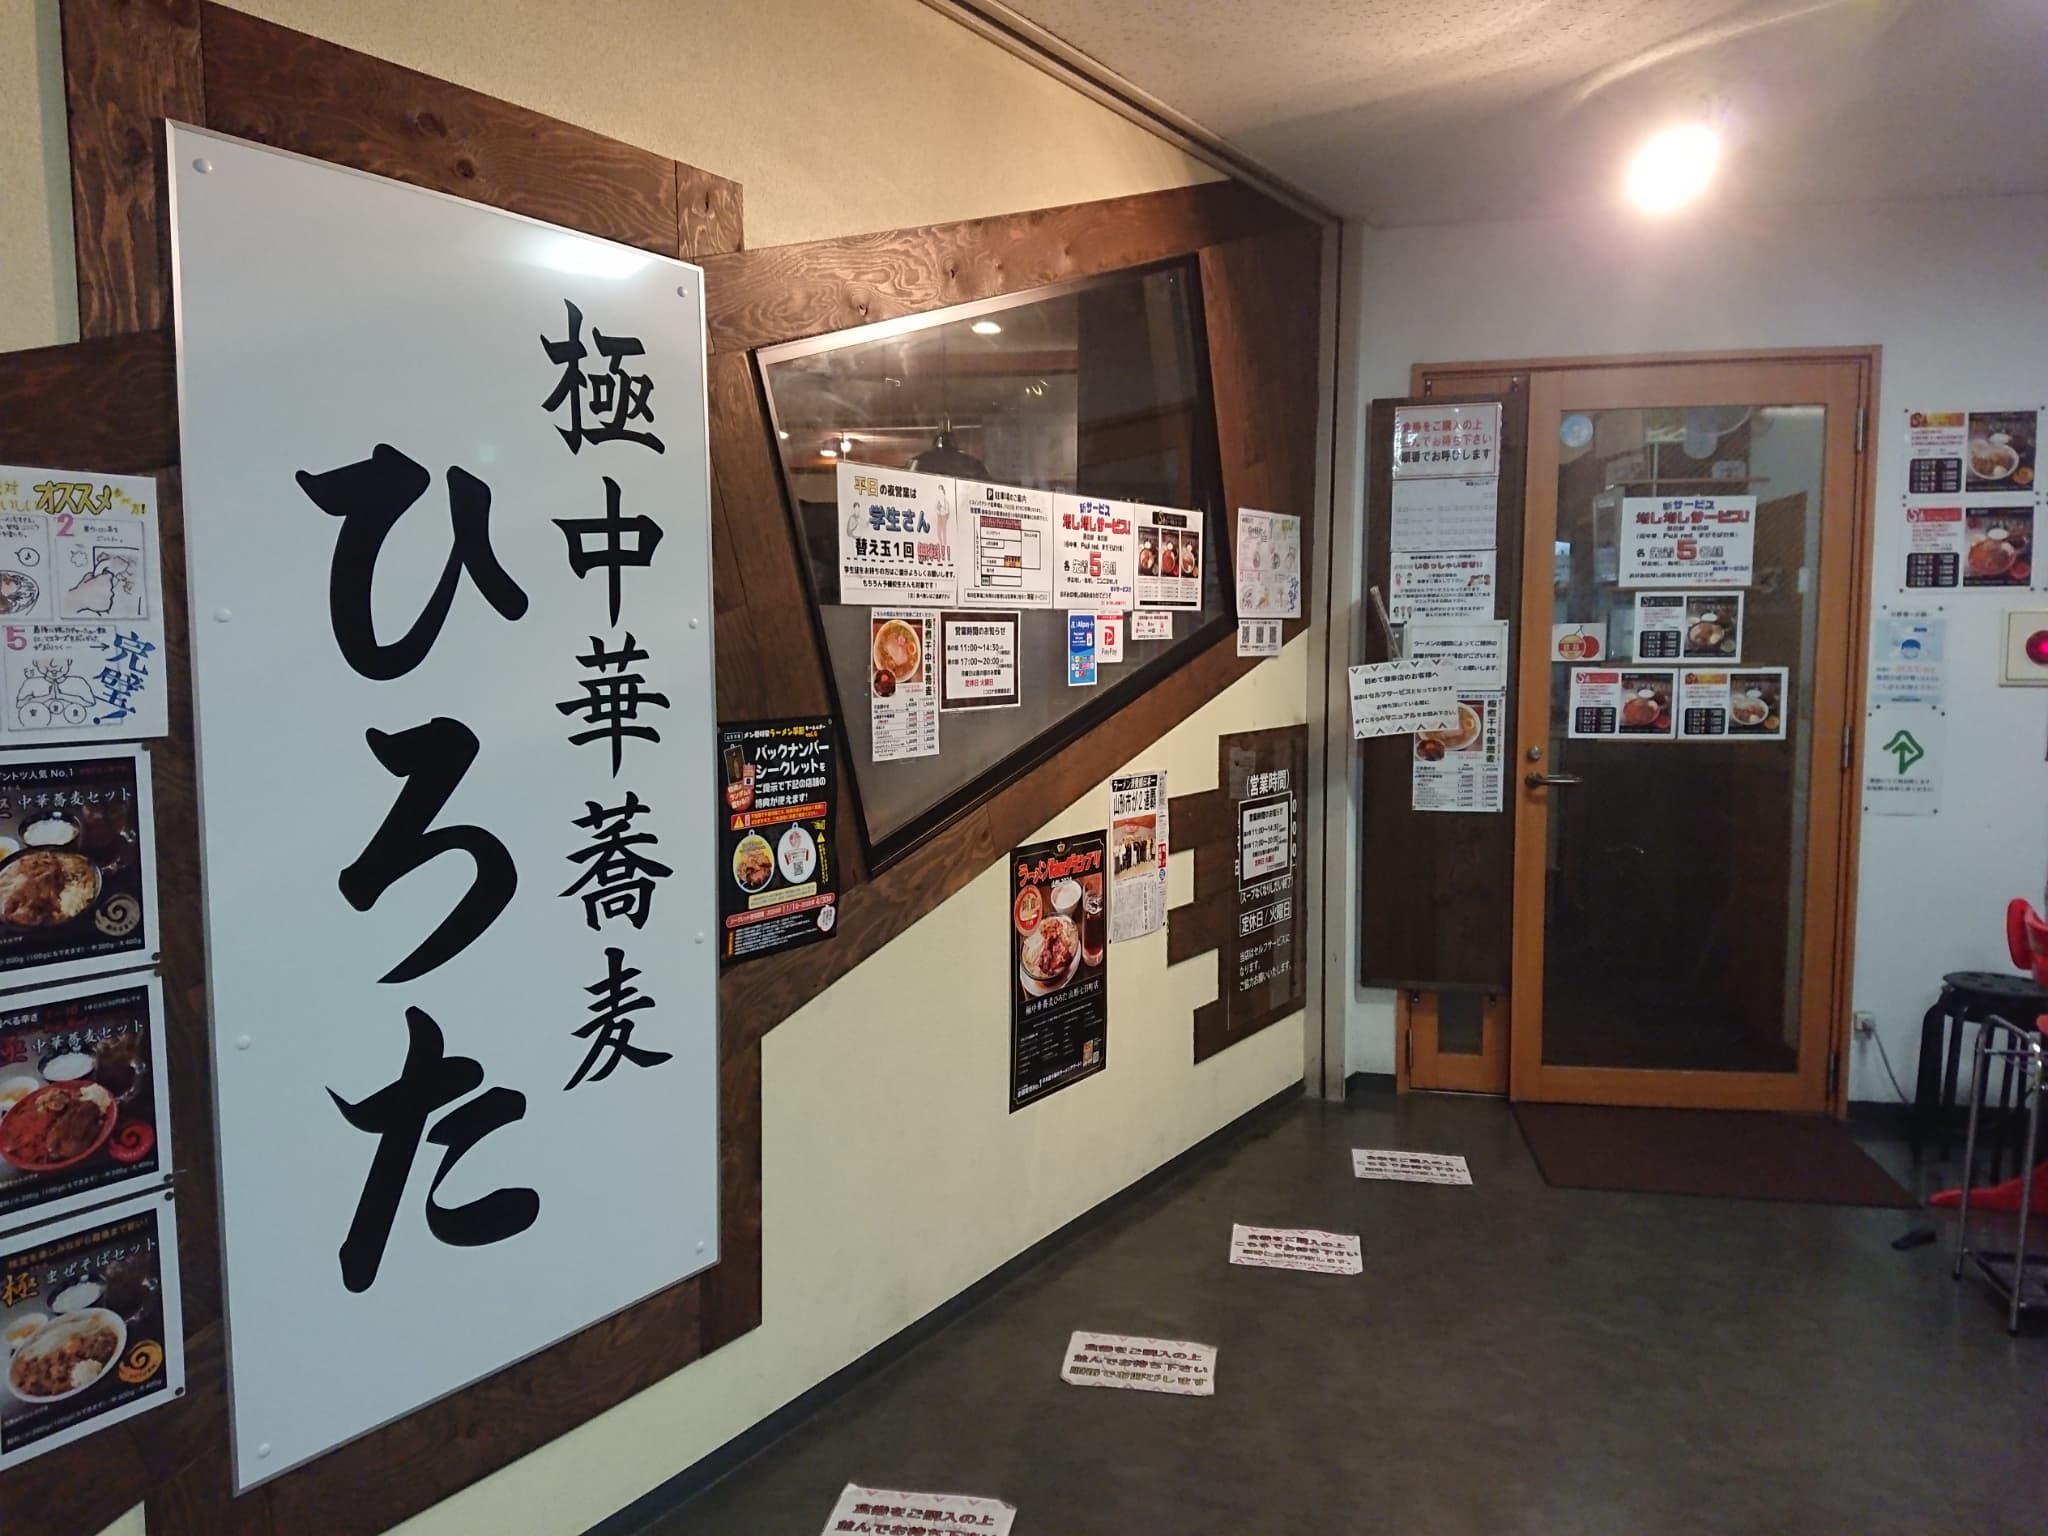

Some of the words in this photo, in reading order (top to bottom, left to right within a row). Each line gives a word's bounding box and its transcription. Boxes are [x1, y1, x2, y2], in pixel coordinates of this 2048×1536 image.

[33, 480, 112, 515] オススメ
[854, 476, 917, 499] 平日の夜営業は
[56, 513, 75, 537] 2
[868, 504, 931, 534] 学生さん
[855, 538, 915, 559] 替え玉1回
[5, 626, 27, 651] 5
[539, 298, 674, 1091] 極中華蕎麦
[755, 740, 830, 761] バックナンバー
[755, 758, 826, 780] シークレットを
[18, 787, 131, 810] 中華蕎麦セット
[296, 444, 540, 1293] ひろた
[3, 1272, 40, 1308] 極
[47, 1238, 157, 1284] まぜそばセット
[1073, 1353, 1208, 1374] 並んでお待ち下さい
[1084, 1343, 1203, 1362] 食券をご購入の上
[852, 1503, 995, 1526] 食券をご購入の上
